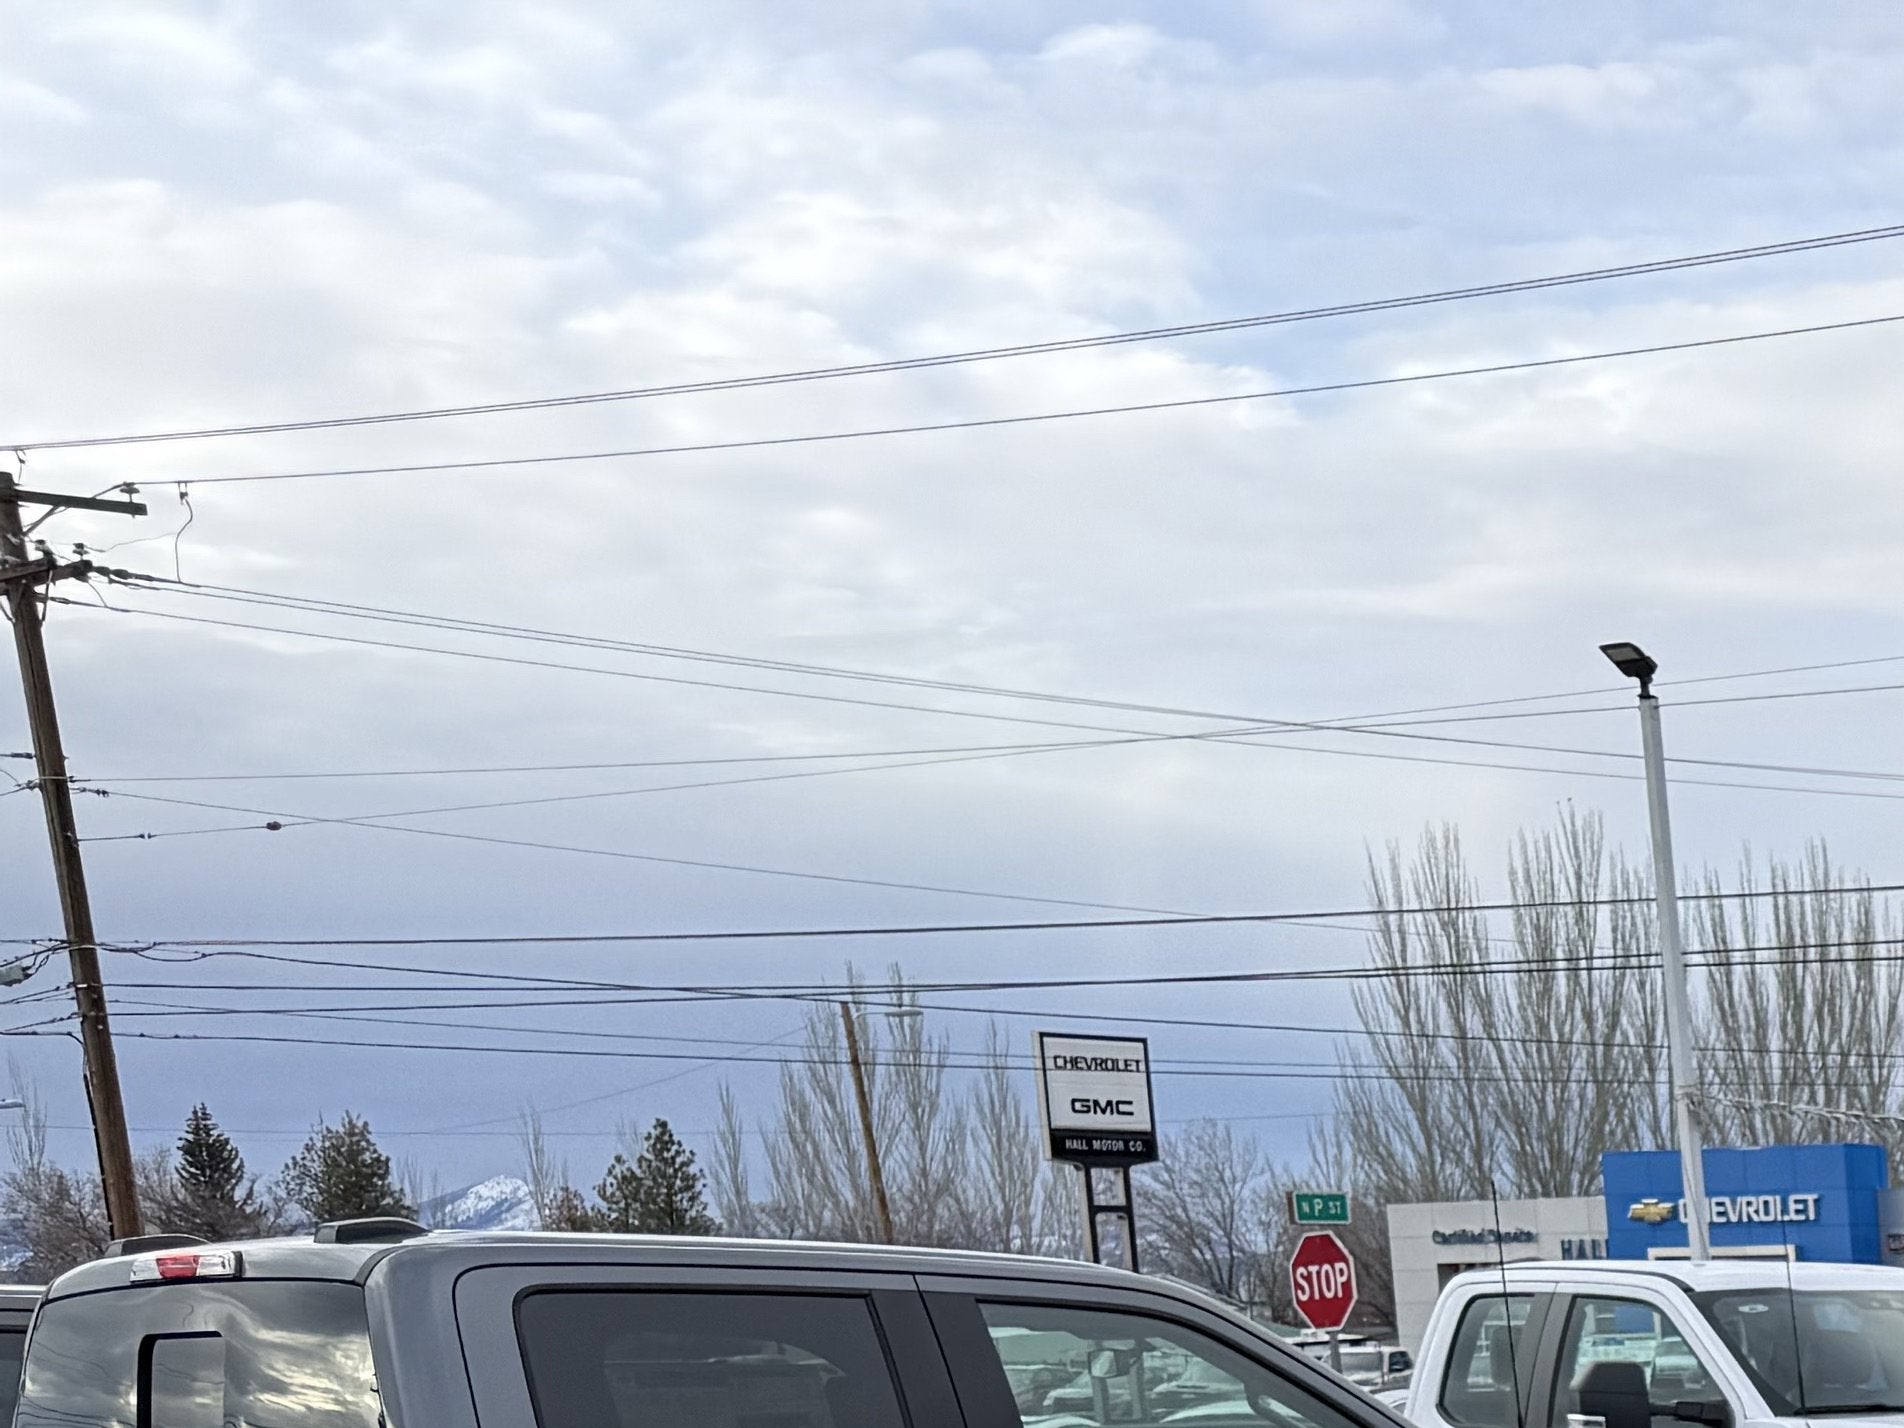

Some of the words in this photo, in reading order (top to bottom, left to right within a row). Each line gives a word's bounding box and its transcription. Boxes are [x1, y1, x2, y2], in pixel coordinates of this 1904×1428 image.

[1053, 1055, 1143, 1073] CHEVROLET
[1071, 1098, 1134, 1116] GMC
[1065, 1139, 1089, 1151] HALL
[1092, 1140, 1125, 1151] MOTOR
[1313, 1198, 1322, 1216] P
[1329, 1202, 1341, 1215] ST
[1296, 1262, 1349, 1301] STOP
